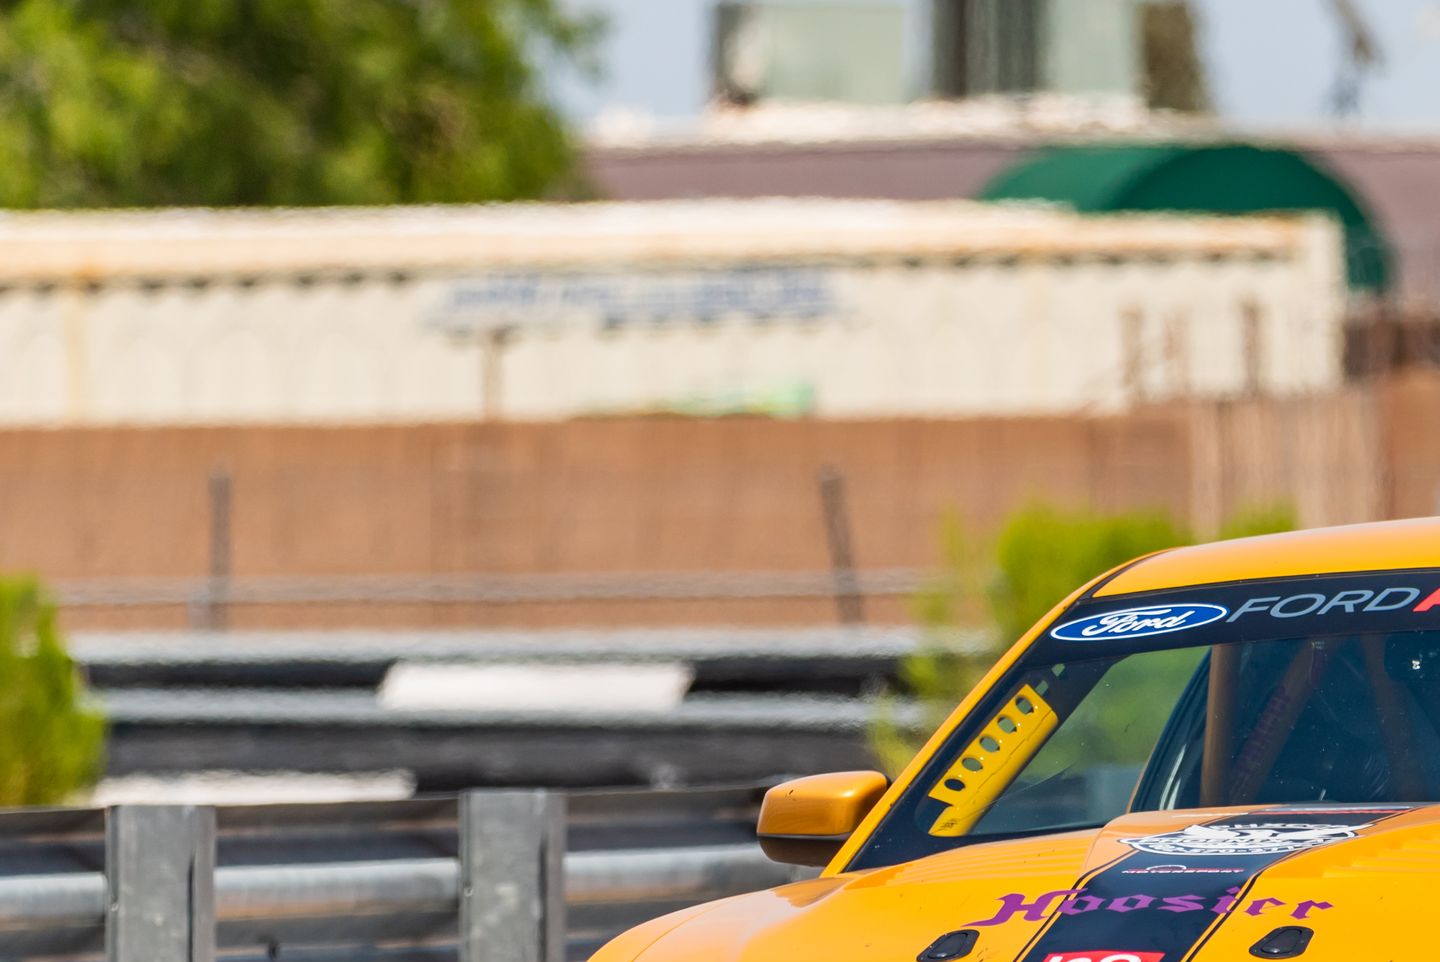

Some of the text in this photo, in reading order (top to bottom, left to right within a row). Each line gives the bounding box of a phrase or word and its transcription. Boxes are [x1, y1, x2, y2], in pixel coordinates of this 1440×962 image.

[1082, 608, 1195, 637] Ford
[1226, 587, 1421, 623] FORD
[961, 887, 1334, 926] Hoosier
